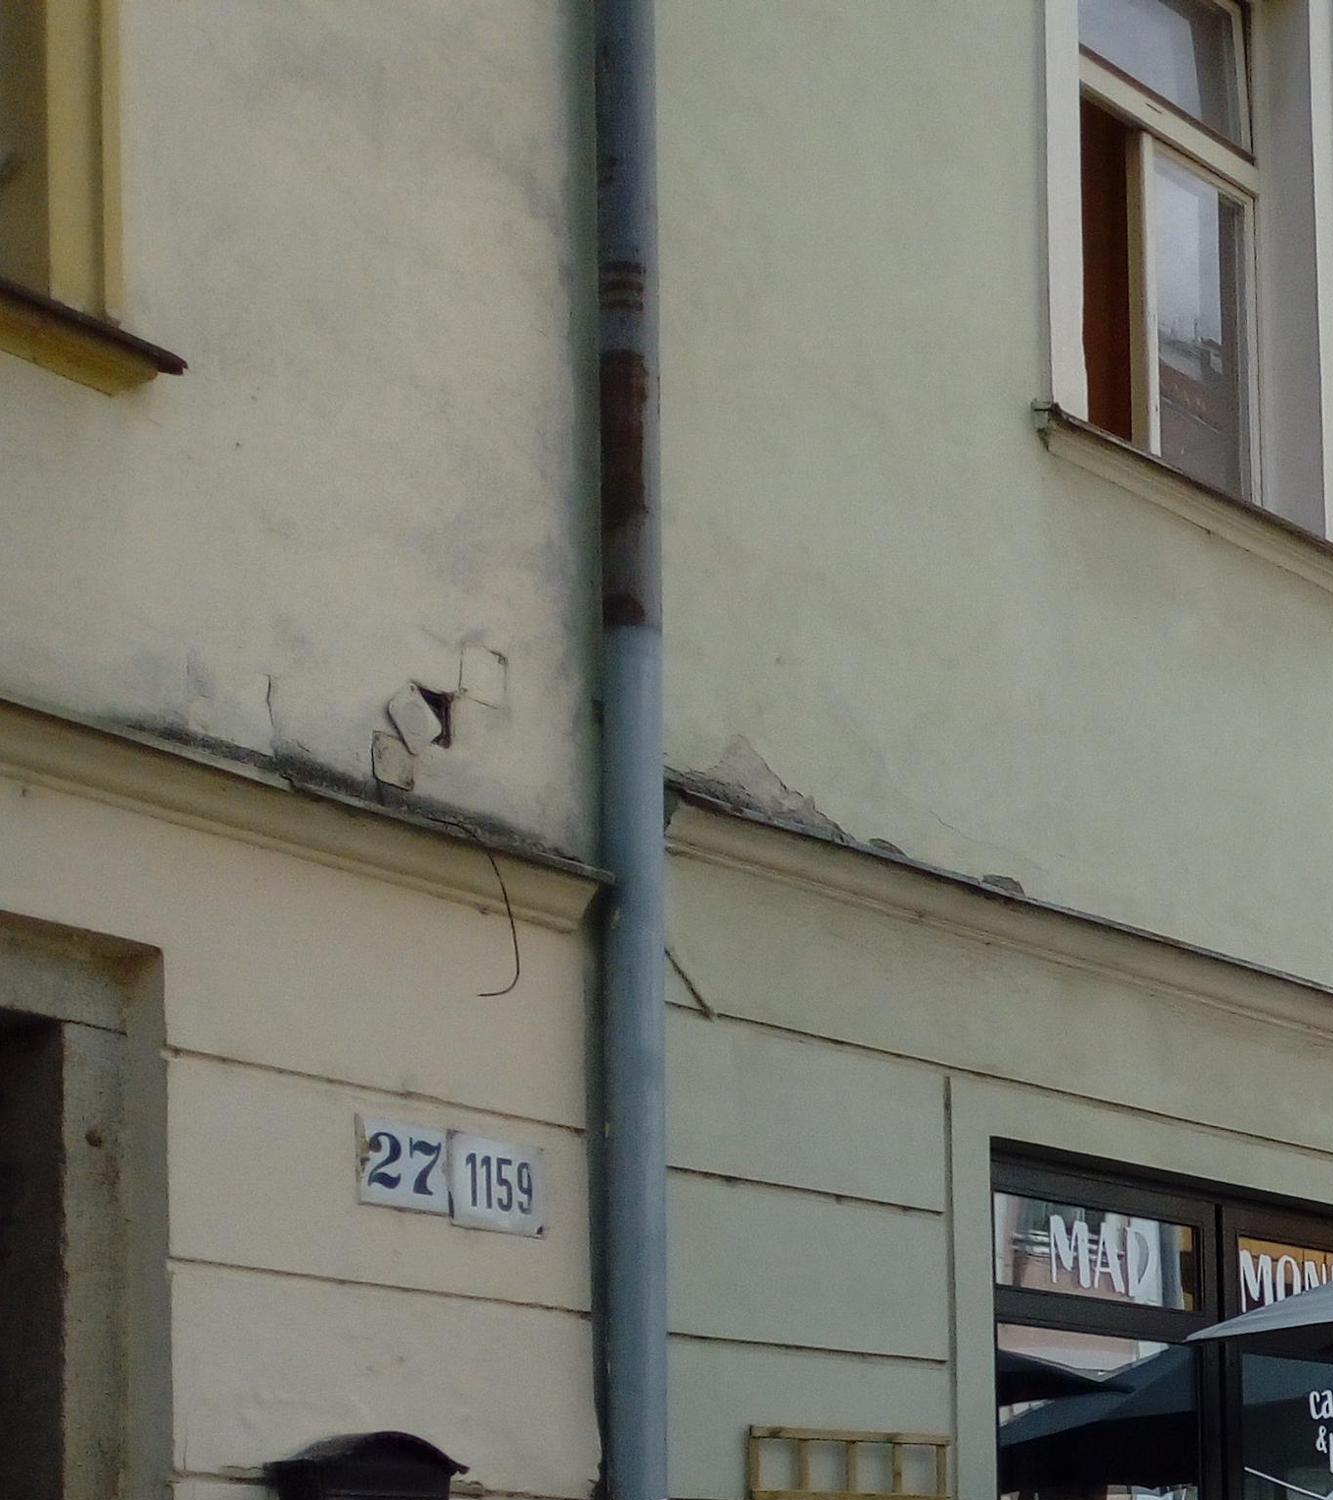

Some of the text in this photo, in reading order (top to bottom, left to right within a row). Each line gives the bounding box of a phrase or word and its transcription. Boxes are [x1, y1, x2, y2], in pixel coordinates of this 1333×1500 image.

[368, 1131, 441, 1196] 27
[466, 1152, 533, 1215] 1159
[1050, 1214, 1154, 1298] MAD
[1315, 1425, 1328, 1454] &
